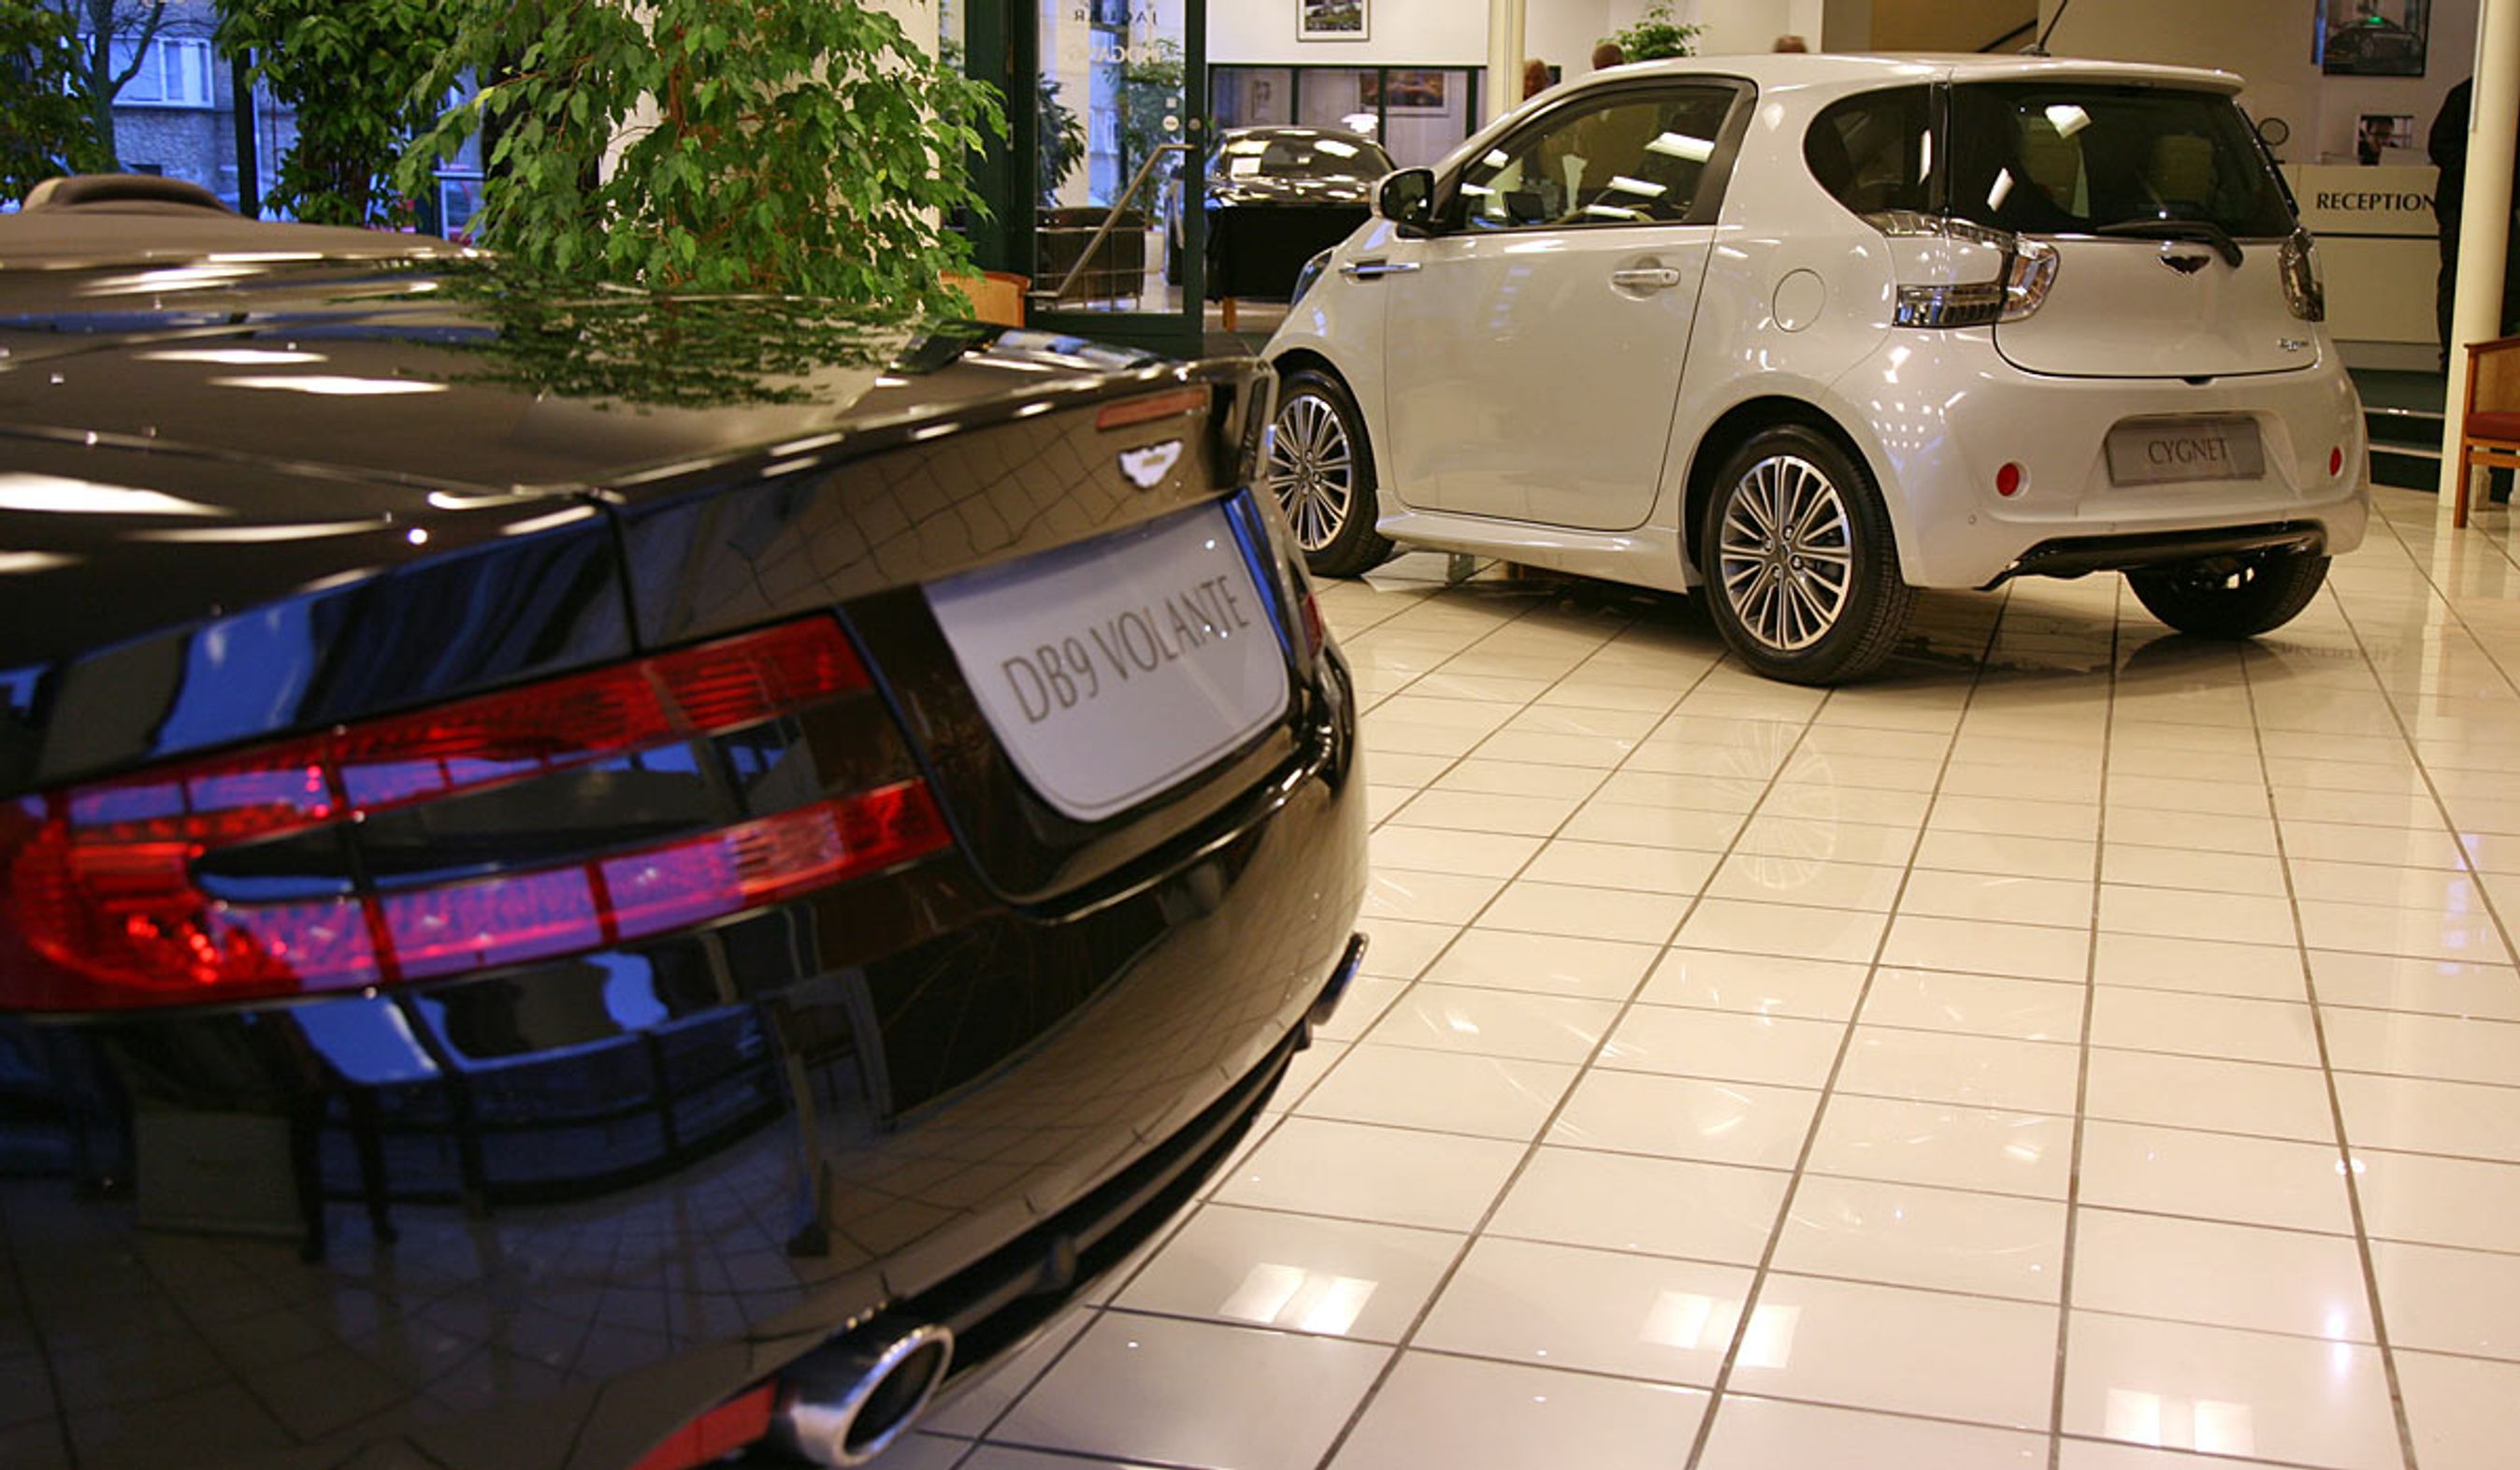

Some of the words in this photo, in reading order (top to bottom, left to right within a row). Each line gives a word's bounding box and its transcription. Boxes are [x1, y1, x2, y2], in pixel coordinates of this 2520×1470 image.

[2316, 192, 2436, 211] RECEPTION
[2148, 437, 2227, 465] CYGNET
[1002, 638, 1099, 724] DB9
[1088, 575, 1249, 681] VOLANTE
